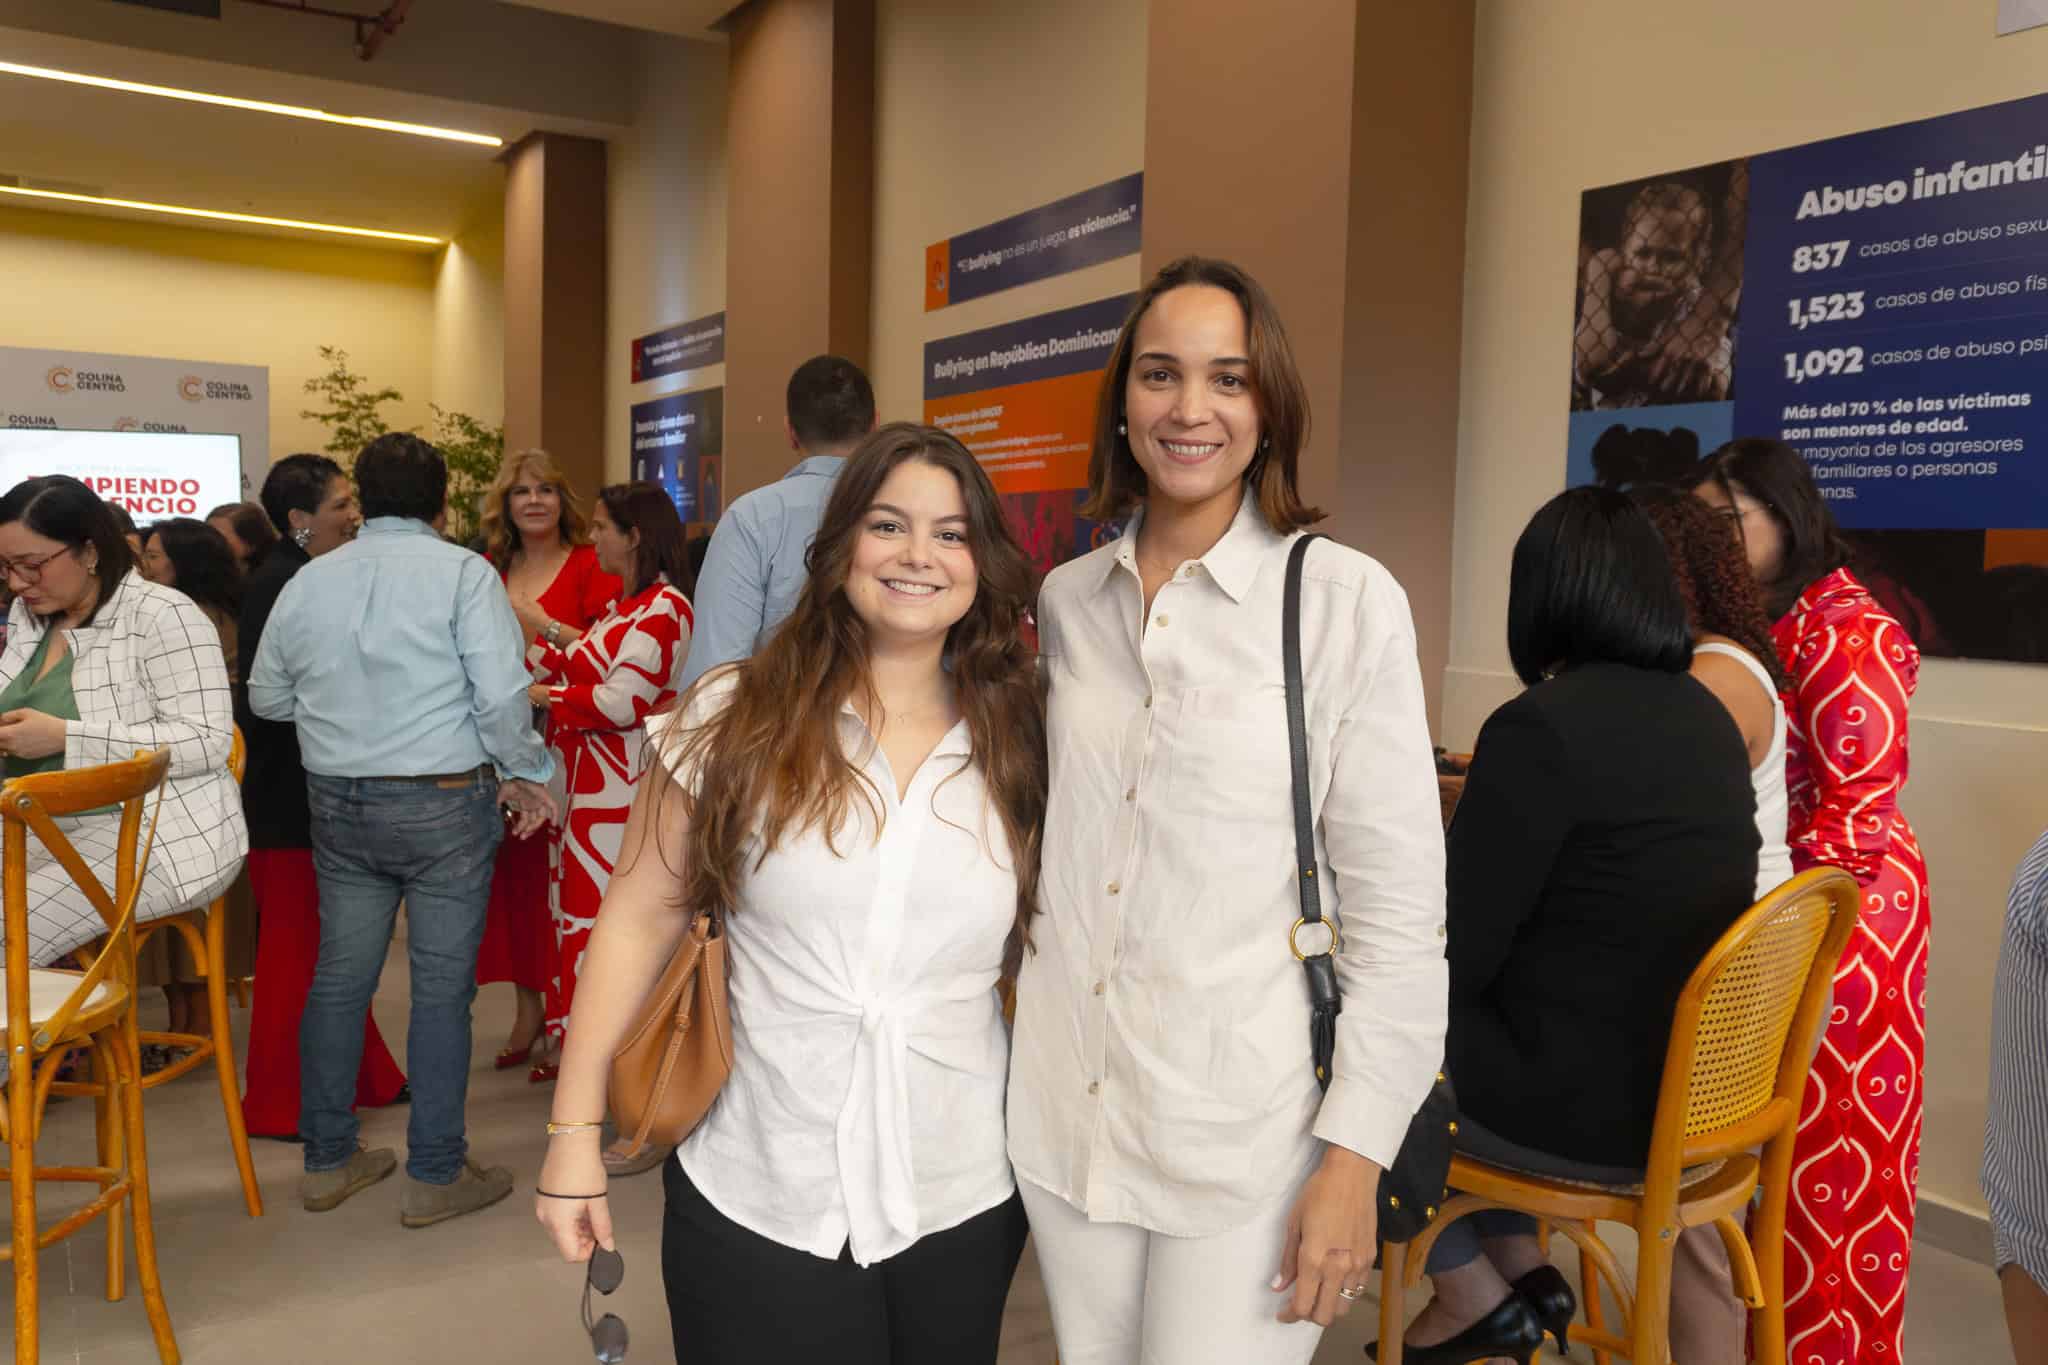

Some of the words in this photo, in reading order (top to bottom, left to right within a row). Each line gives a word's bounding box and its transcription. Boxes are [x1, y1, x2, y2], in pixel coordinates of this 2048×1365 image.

[1796, 181, 1907, 220] Abuso
[1913, 144, 2048, 200] infanti
[1792, 240, 1850, 272] 837
[1860, 237, 1910, 257] casos
[1914, 232, 1938, 249] de
[1943, 225, 2001, 245] abuso
[1788, 292, 1865, 330] 1,523
[1876, 291, 1927, 309] casos
[1931, 286, 1954, 302] de
[1960, 281, 2020, 298] abuso
[1784, 346, 1864, 384] 1,092
[1871, 346, 1922, 365] casos
[1927, 343, 1950, 360] de
[1955, 341, 2015, 357] abuso
[77, 372, 123, 383] COLINA
[77, 381, 126, 392] CENTRO
[206, 382, 249, 392] COLINA
[206, 391, 252, 400] CENTRO
[1784, 404, 1817, 419] Más
[1821, 402, 1847, 418] del
[1849, 401, 1869, 416] 70
[1872, 400, 1887, 415] %
[1891, 398, 1914, 414] de
[1917, 397, 1944, 412] las
[9, 414, 57, 425] COLINA
[143, 422, 187, 433] COLINA
[1783, 427, 1811, 440] son
[1814, 422, 1886, 438] menores
[1889, 419, 1912, 434] de
[1915, 416, 1968, 434] edad.
[1875, 441, 1897, 456] de
[1902, 440, 1926, 455] los
[1930, 438, 2024, 457] agresores
[1812, 463, 1892, 479] familiares
[1895, 464, 1908, 477] o
[1912, 461, 1998, 480] personas
